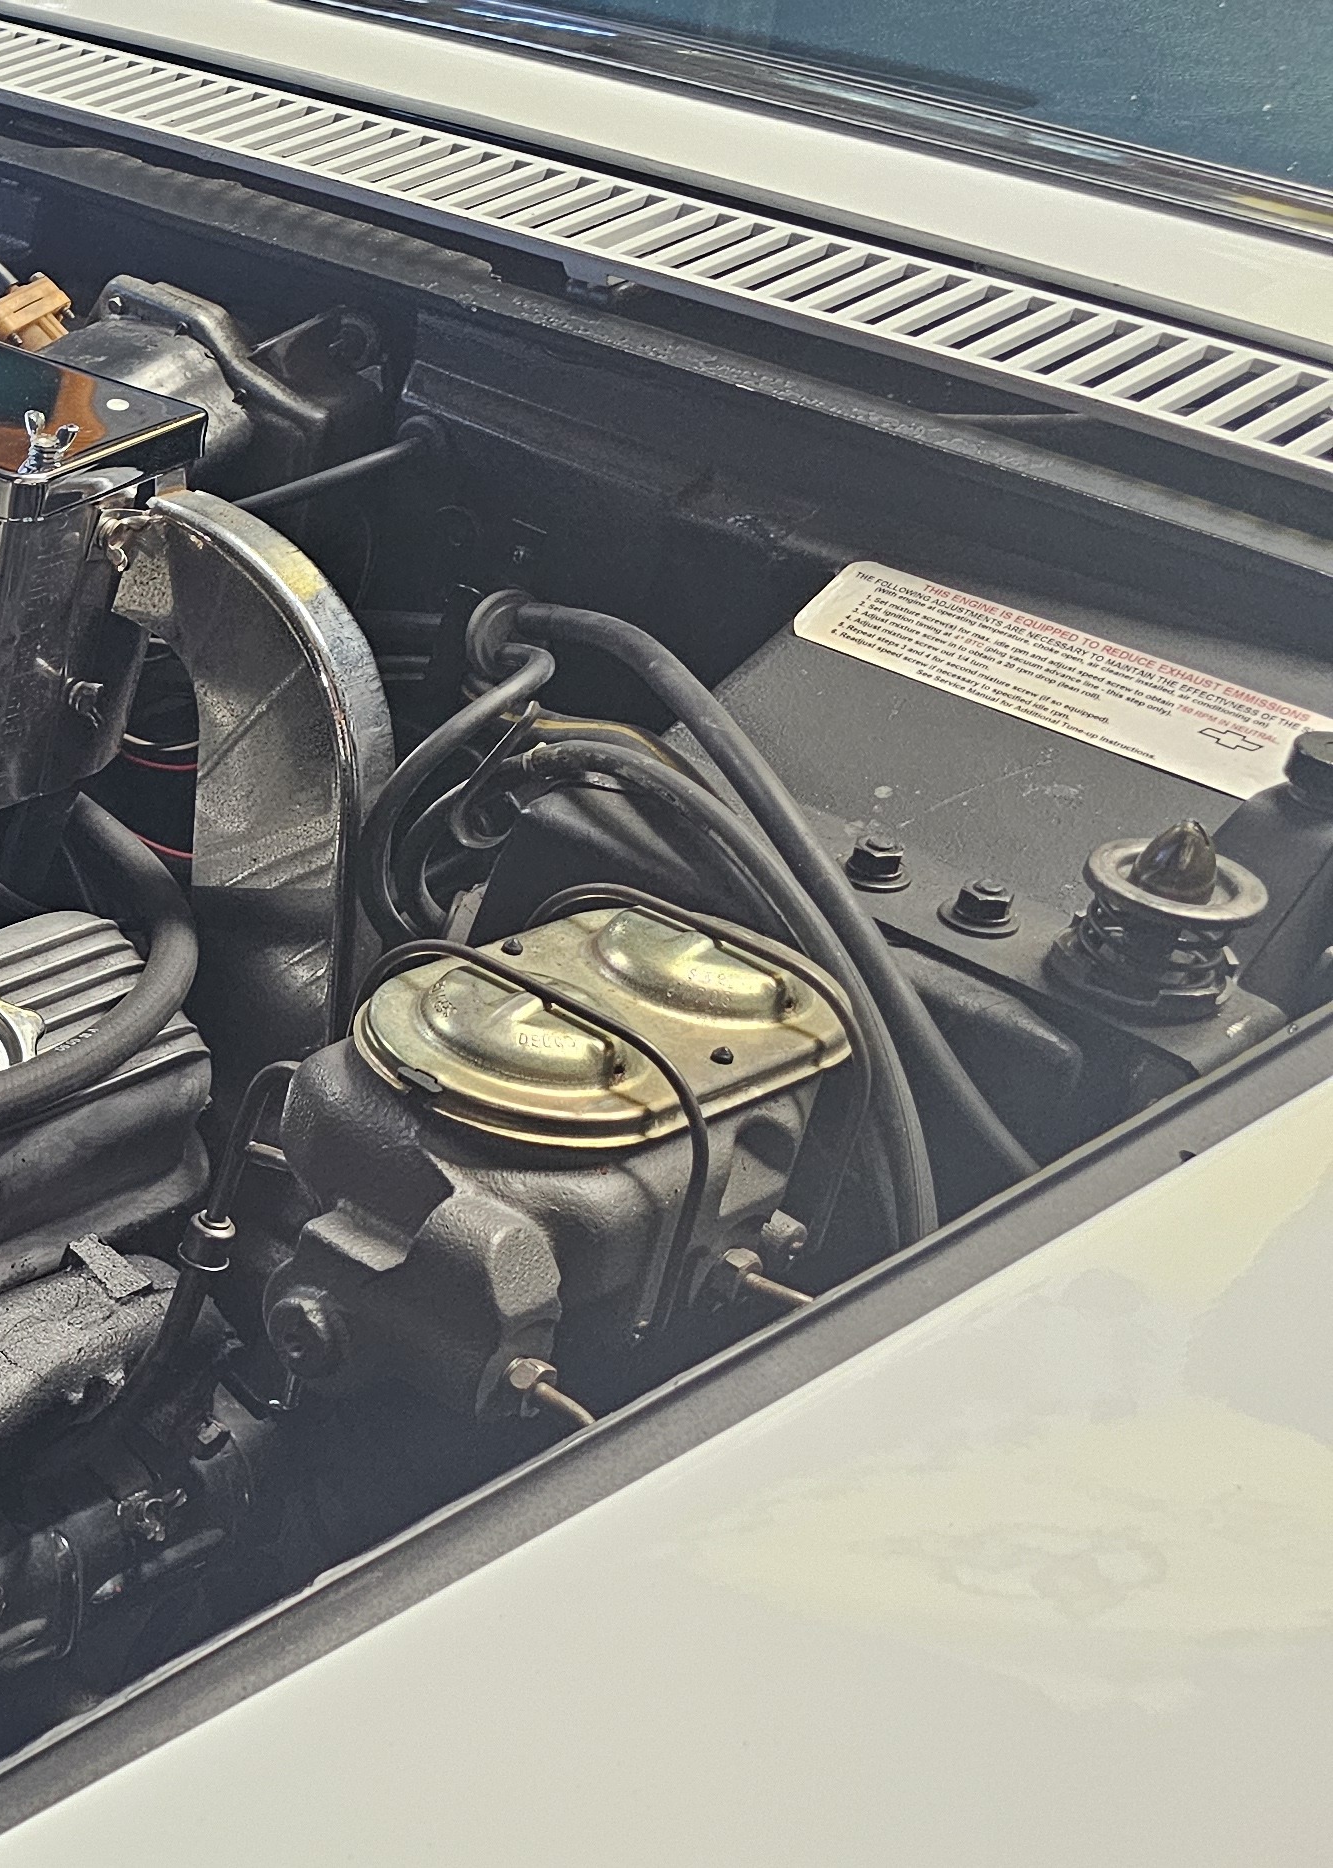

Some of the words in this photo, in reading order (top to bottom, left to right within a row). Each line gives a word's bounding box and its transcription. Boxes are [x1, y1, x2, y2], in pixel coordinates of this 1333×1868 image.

[839, 631, 876, 648] Readjust
[876, 646, 903, 657] speed
[902, 656, 928, 667] screw
[935, 668, 979, 687] necessary
[991, 688, 1032, 705] specified
[1031, 701, 1049, 711] idle
[846, 624, 876, 638] Repeat
[876, 636, 899, 647] steps
[906, 647, 925, 656] and
[931, 655, 945, 663] for
[945, 661, 978, 675] second
[977, 673, 1010, 687] mixture
[1011, 685, 1038, 697] screw
[853, 617, 881, 630] Adjust
[880, 628, 913, 642] mixture
[914, 640, 939, 651] screw
[940, 649, 955, 657] out
[855, 571, 875, 582] THE
[874, 578, 931, 601] FOLLOWING
[931, 598, 1003, 626] ADJUSTMENTS
[1002, 623, 1026, 634] ARE
[1026, 631, 1088, 655] NECESSARY
[1089, 652, 1104, 662] TO
[1105, 658, 1155, 679] MAINTAIN
[1156, 675, 1178, 687] THE
[1179, 684, 1259, 715] EFFECTIVNESS
[1260, 712, 1278, 721] OF
[1278, 717, 1300, 729] THE
[860, 610, 889, 623] Adjust
[888, 621, 920, 635] mixture
[921, 633, 947, 644] screw
[968, 649, 995, 662] obtain
[1015, 666, 1034, 676] rpm
[1034, 673, 1056, 684] drop
[1056, 681, 1079, 692] (lean
[867, 603, 882, 612] Set
[882, 609, 914, 623] ignition
[915, 620, 942, 634] timing
[963, 637, 984, 648] BTC
[983, 645, 1007, 657] (plug
[1008, 654, 1043, 669] vacuum
[1043, 667, 1081, 683] advance
[1082, 680, 1099, 689] line
[1106, 688, 1123, 698] this
[1125, 696, 1145, 706] step
[873, 597, 889, 605] Set
[888, 603, 920, 616] mixture
[921, 615, 957, 630] screw(s)
[957, 626, 971, 634] for
[993, 639, 1009, 648] idle
[1010, 646, 1029, 656] rpm
[1029, 653, 1048, 662] and
[1047, 660, 1076, 672] adjust
[1077, 670, 1105, 682] speed
[1105, 680, 1133, 692] screw
[1144, 694, 1174, 707] obtain
[873, 586, 897, 597] (With
[897, 595, 925, 607] engine
[936, 608, 977, 626] operating
[977, 622, 1029, 645] temperature,
[1032, 642, 1059, 654] choke
[1060, 652, 1083, 664] open,
[1100, 666, 1134, 680] cleaner
[1135, 677, 1174, 695] installed,
[1191, 698, 1250, 722] conditioning
[1252, 719, 1269, 728] on)
[923, 583, 950, 597] THIS
[951, 594, 998, 614] ENGINE
[998, 610, 1013, 619] IS
[1014, 615, 1078, 641] EQUIPPED
[1081, 637, 1099, 649] TO
[1100, 644, 1156, 668] REDUCE
[1157, 663, 1222, 690] EXHAUST
[1222, 686, 1309, 721] EMMISSIONS
[915, 669, 932, 678] See
[933, 675, 965, 690] Service
[966, 687, 1000, 702] Manual
[999, 699, 1013, 707] for
[1013, 705, 1060, 724] Additional
[1061, 721, 1098, 738] Tune-up
